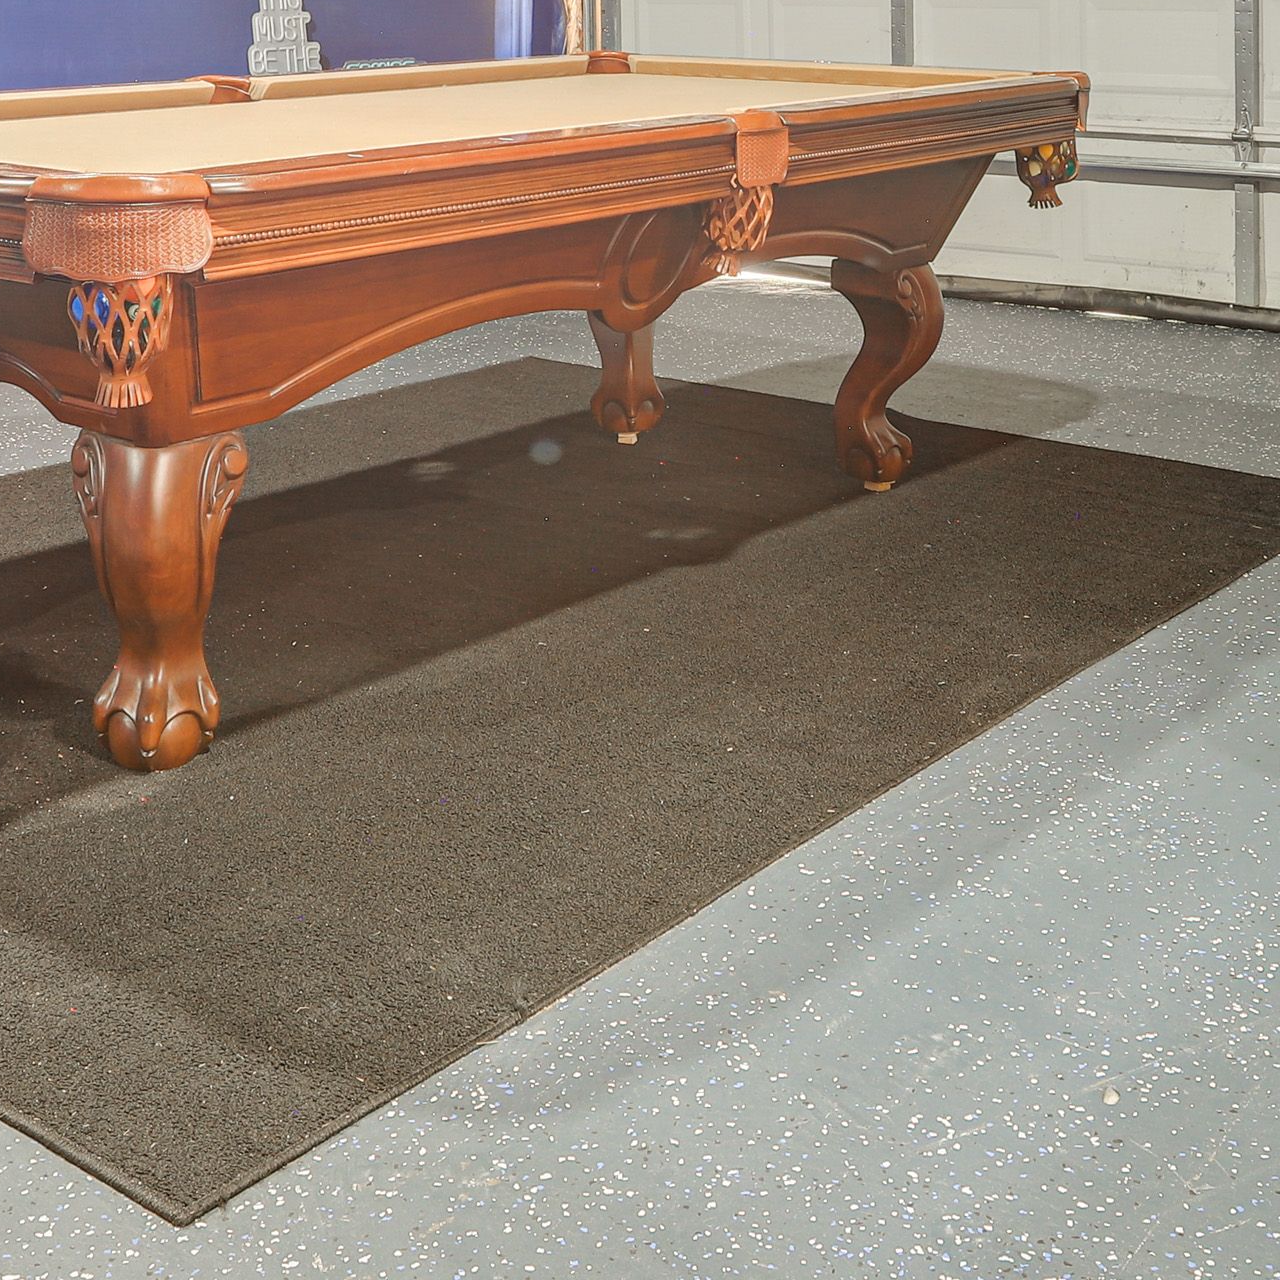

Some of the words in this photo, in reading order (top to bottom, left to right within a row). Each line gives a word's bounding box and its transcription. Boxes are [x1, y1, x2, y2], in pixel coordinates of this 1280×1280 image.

[253, 14, 311, 44] MUST
[250, 46, 278, 74] BE
[280, 44, 321, 73] THE
